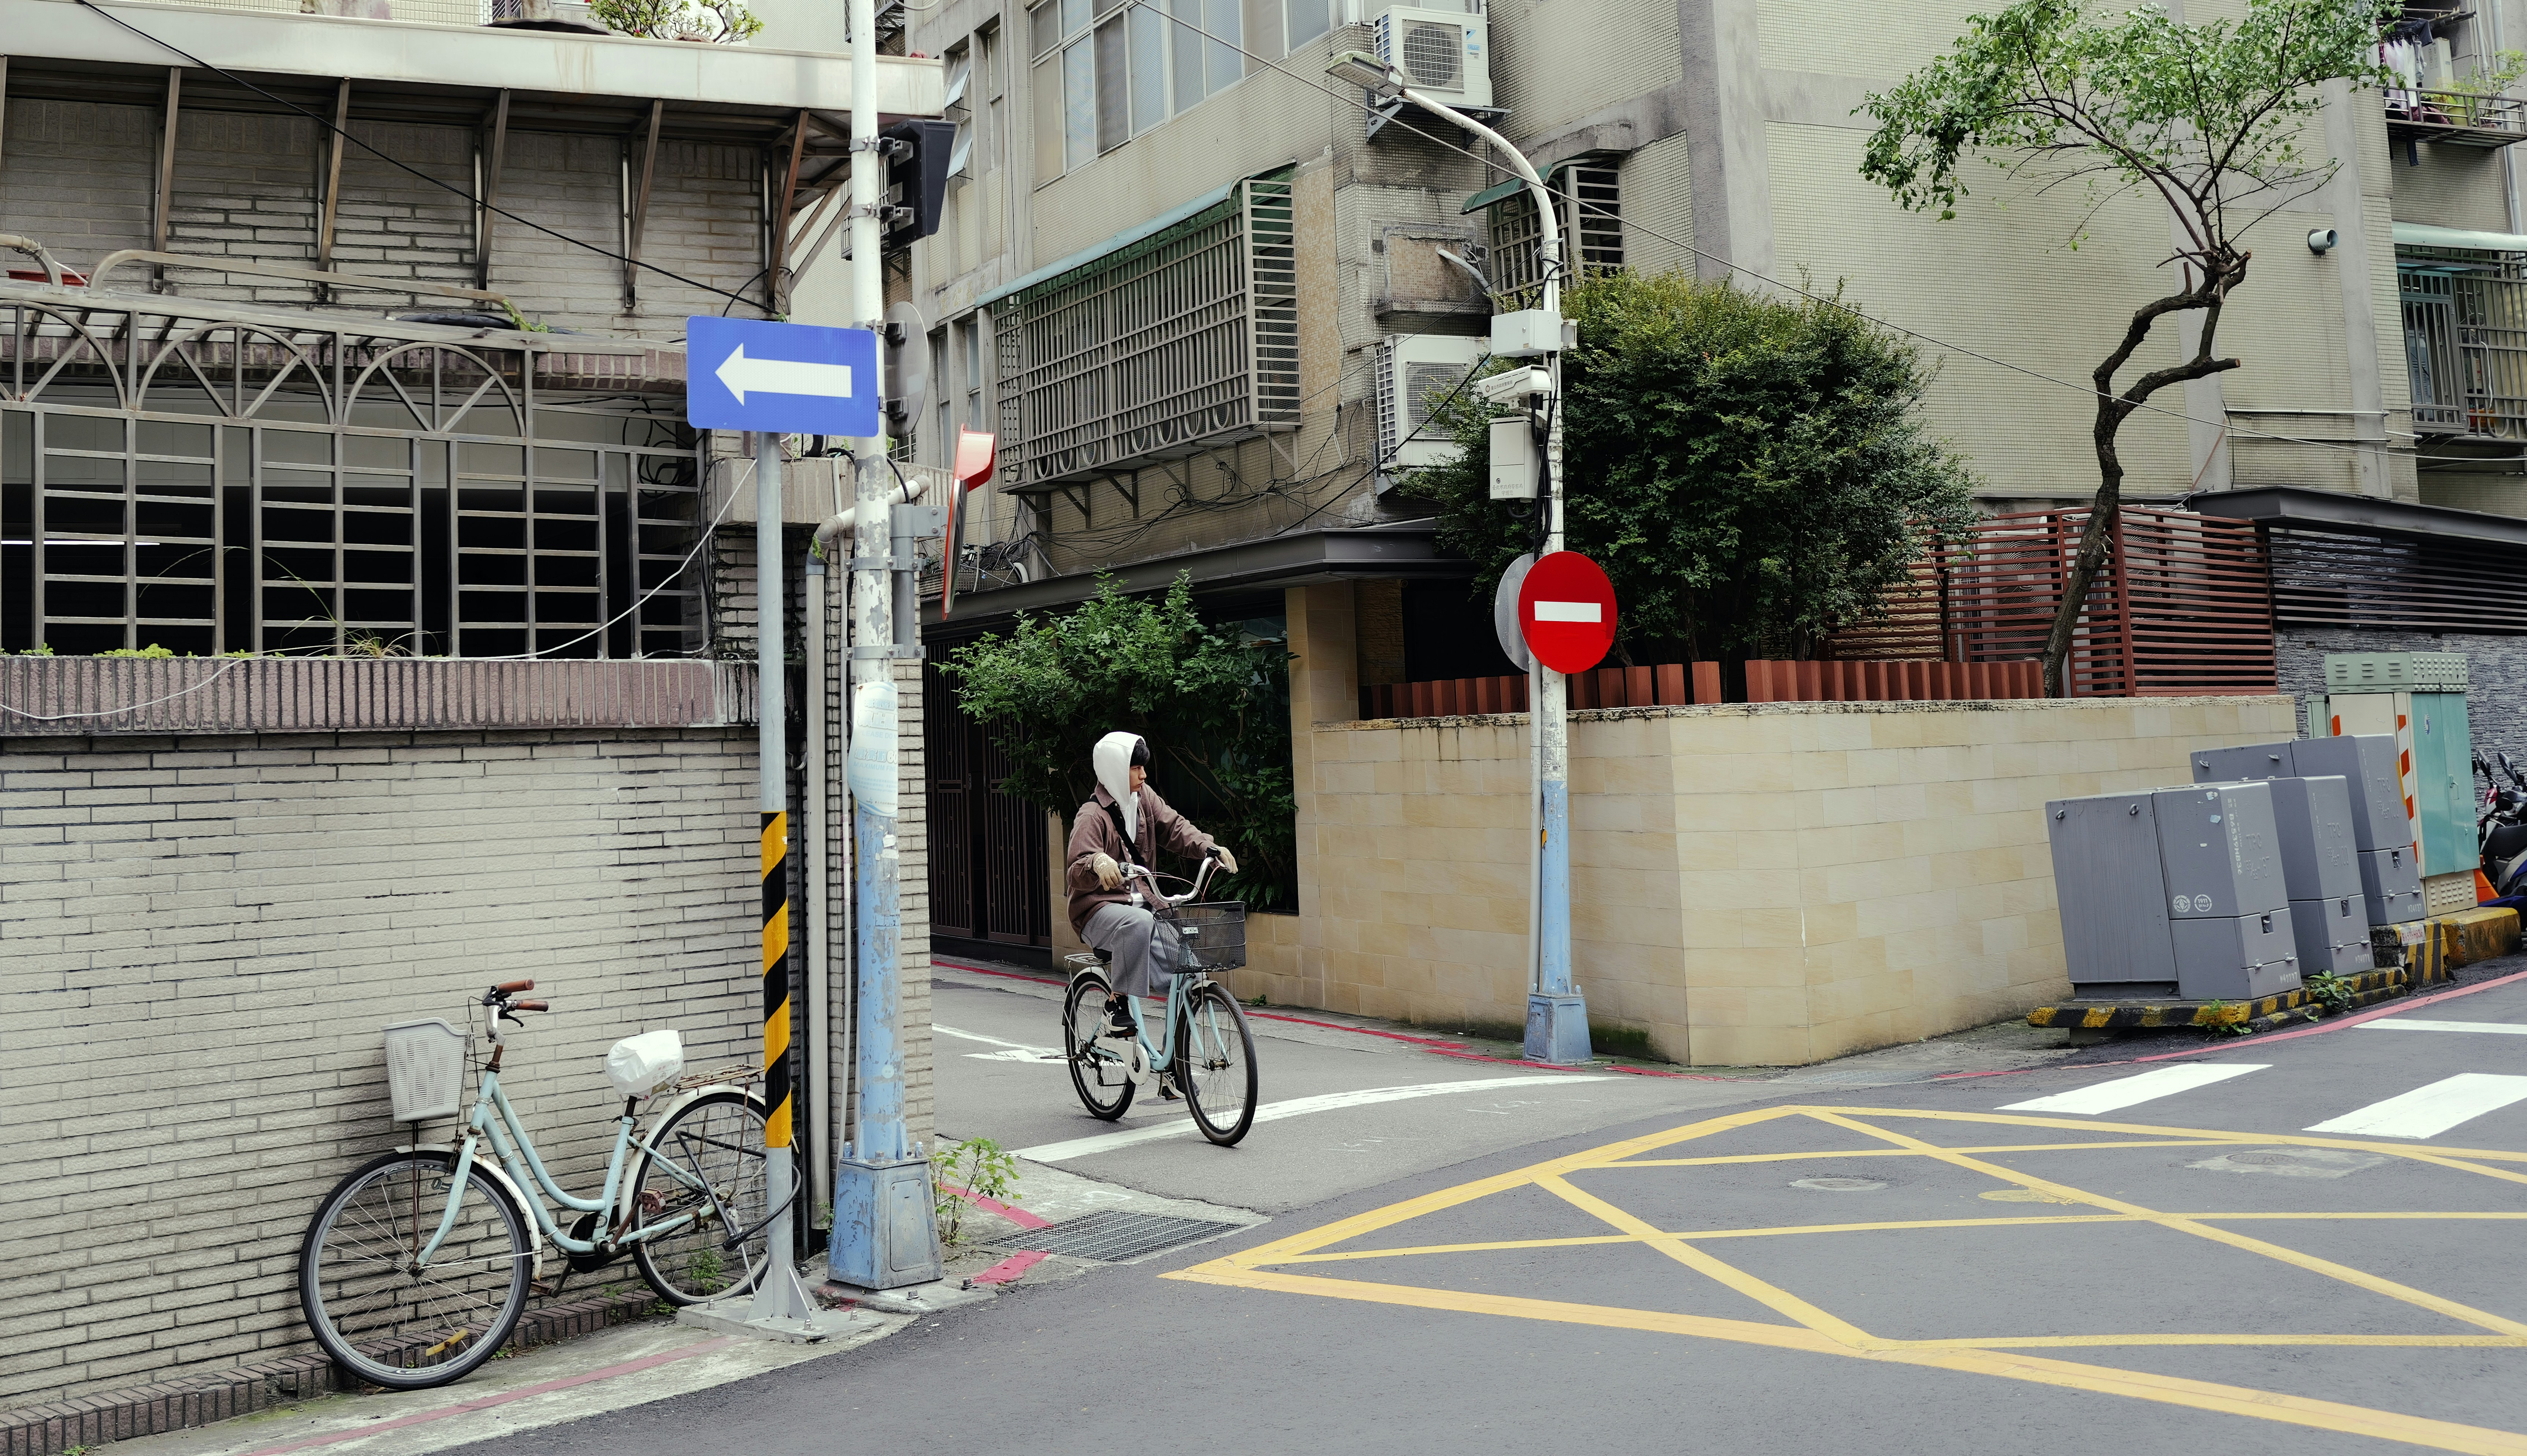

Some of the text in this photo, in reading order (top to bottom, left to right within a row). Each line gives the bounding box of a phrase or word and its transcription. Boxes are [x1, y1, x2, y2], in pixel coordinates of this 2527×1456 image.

[853, 762, 885, 770] MAXIMUM
[2327, 823, 2341, 838] TPC
[2229, 814, 2242, 875] B6539HB36
[2245, 833, 2262, 851] TPC
